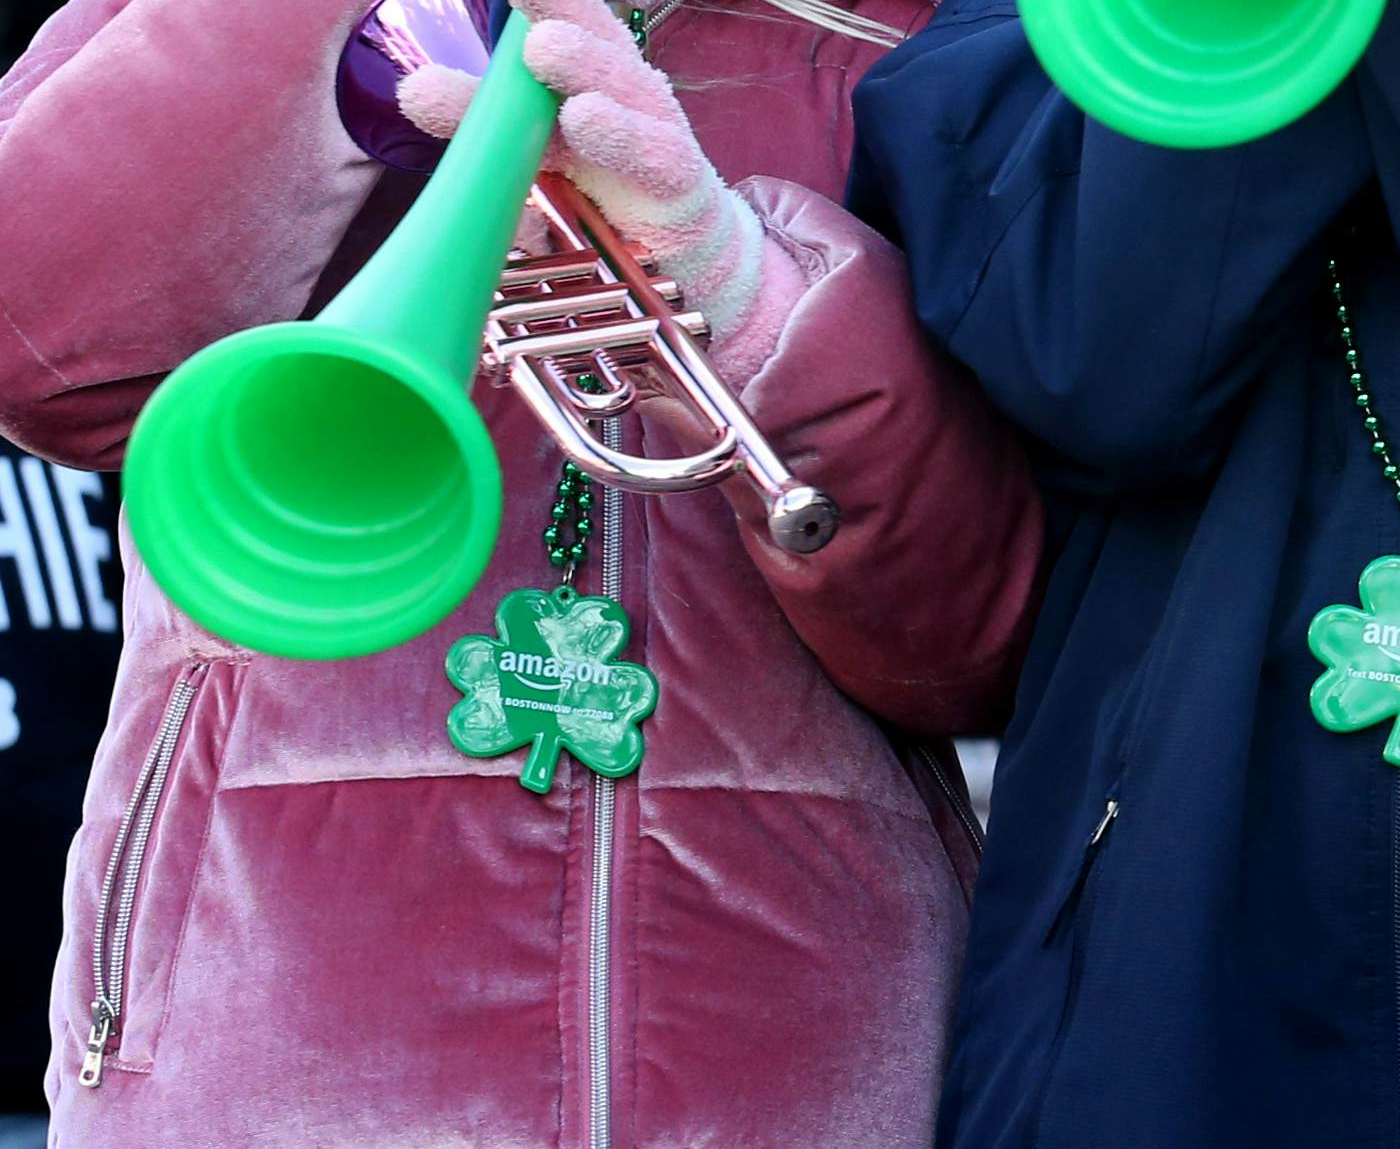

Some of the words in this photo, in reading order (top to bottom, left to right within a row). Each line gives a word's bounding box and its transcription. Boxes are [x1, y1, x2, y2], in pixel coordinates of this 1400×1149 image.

[499, 650, 610, 685] amazon
[1346, 667, 1368, 679] Text
[505, 697, 572, 714] BOSTONNOW
